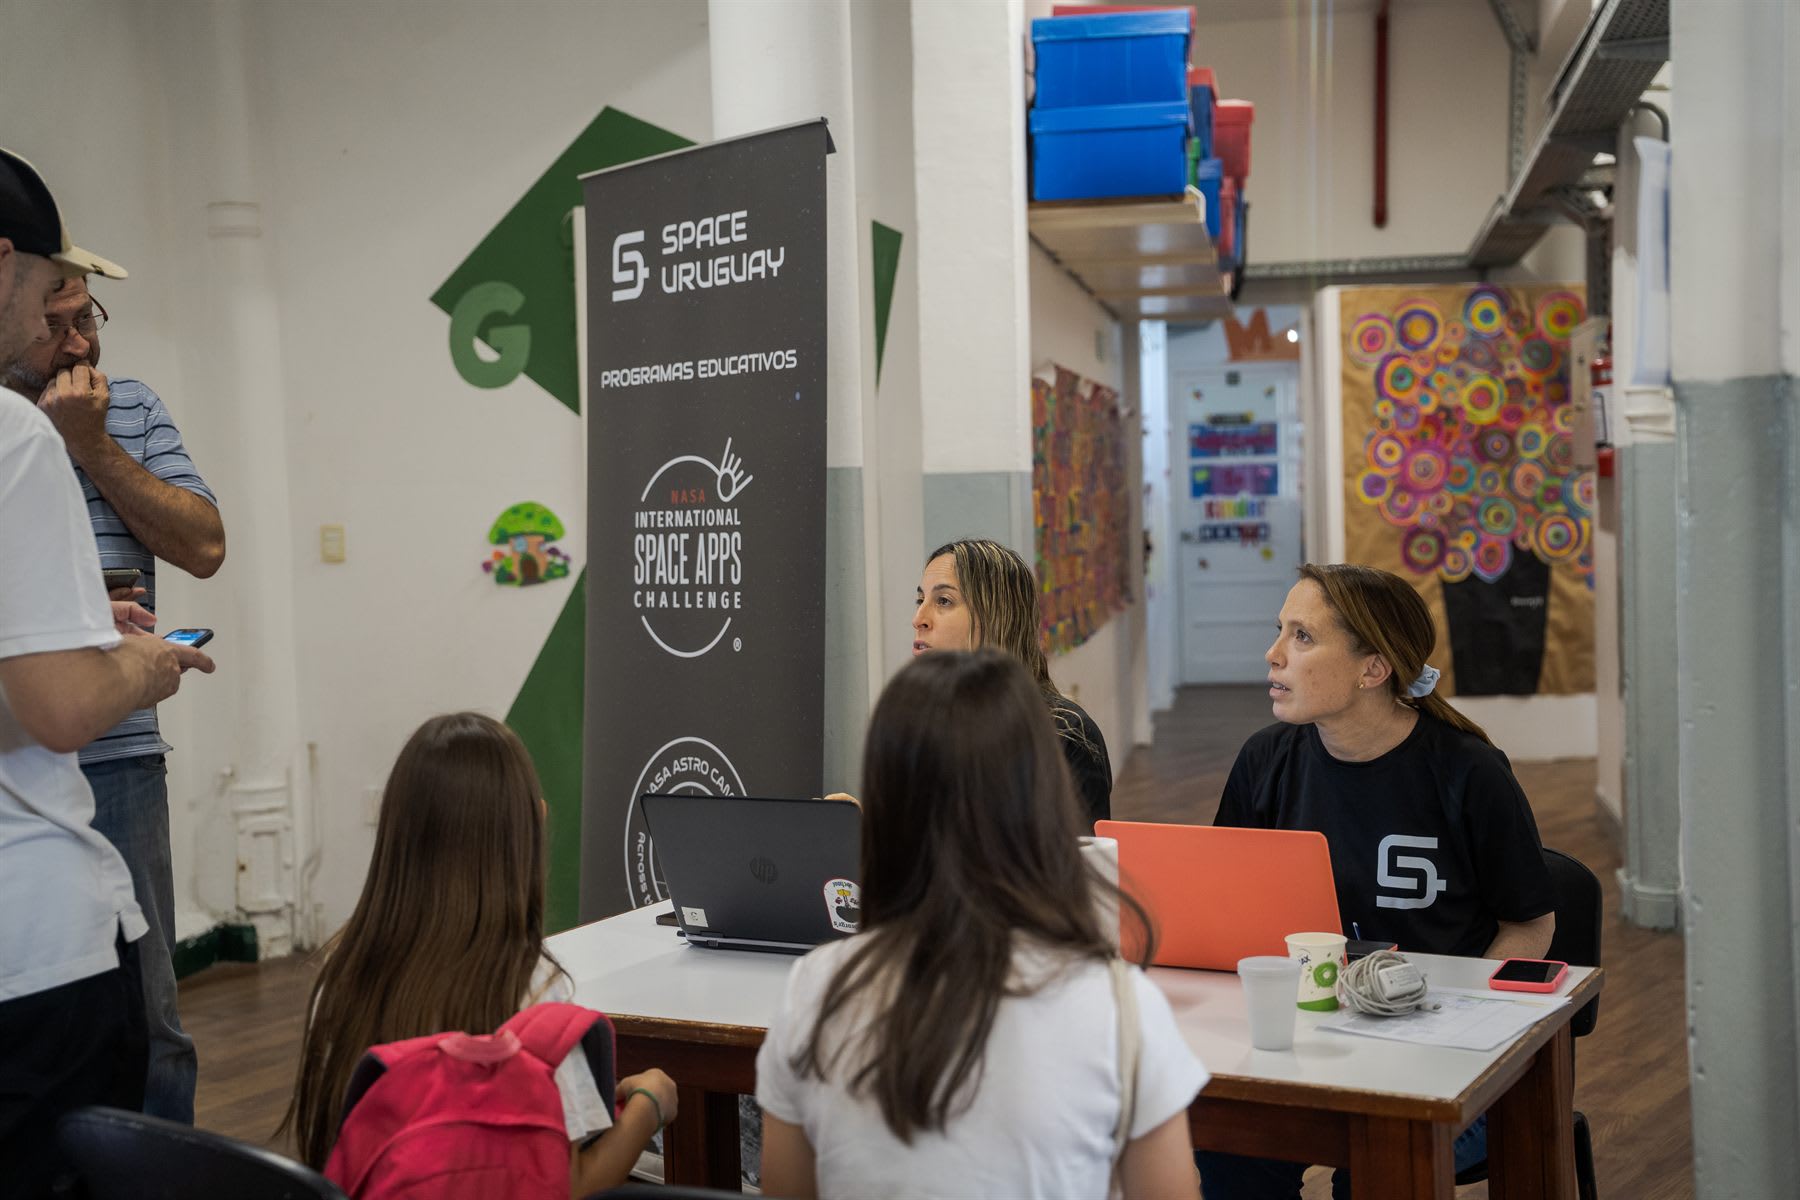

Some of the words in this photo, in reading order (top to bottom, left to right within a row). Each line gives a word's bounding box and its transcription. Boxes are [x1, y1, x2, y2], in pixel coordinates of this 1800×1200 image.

[662, 210, 747, 255] SPACE
[661, 247, 785, 294] URUGUAY
[450, 281, 531, 390] G
[601, 361, 694, 389] PROGRAMAS
[698, 349, 797, 379] EDUCATIVOS
[671, 488, 706, 505] NASA
[635, 508, 741, 528] INTERNATIONAL
[634, 533, 690, 585] SPACE
[695, 531, 742, 585] APPS
[633, 590, 742, 609] CHALLENGE
[645, 765, 672, 794] ASA
[673, 757, 709, 775] ASTRO
